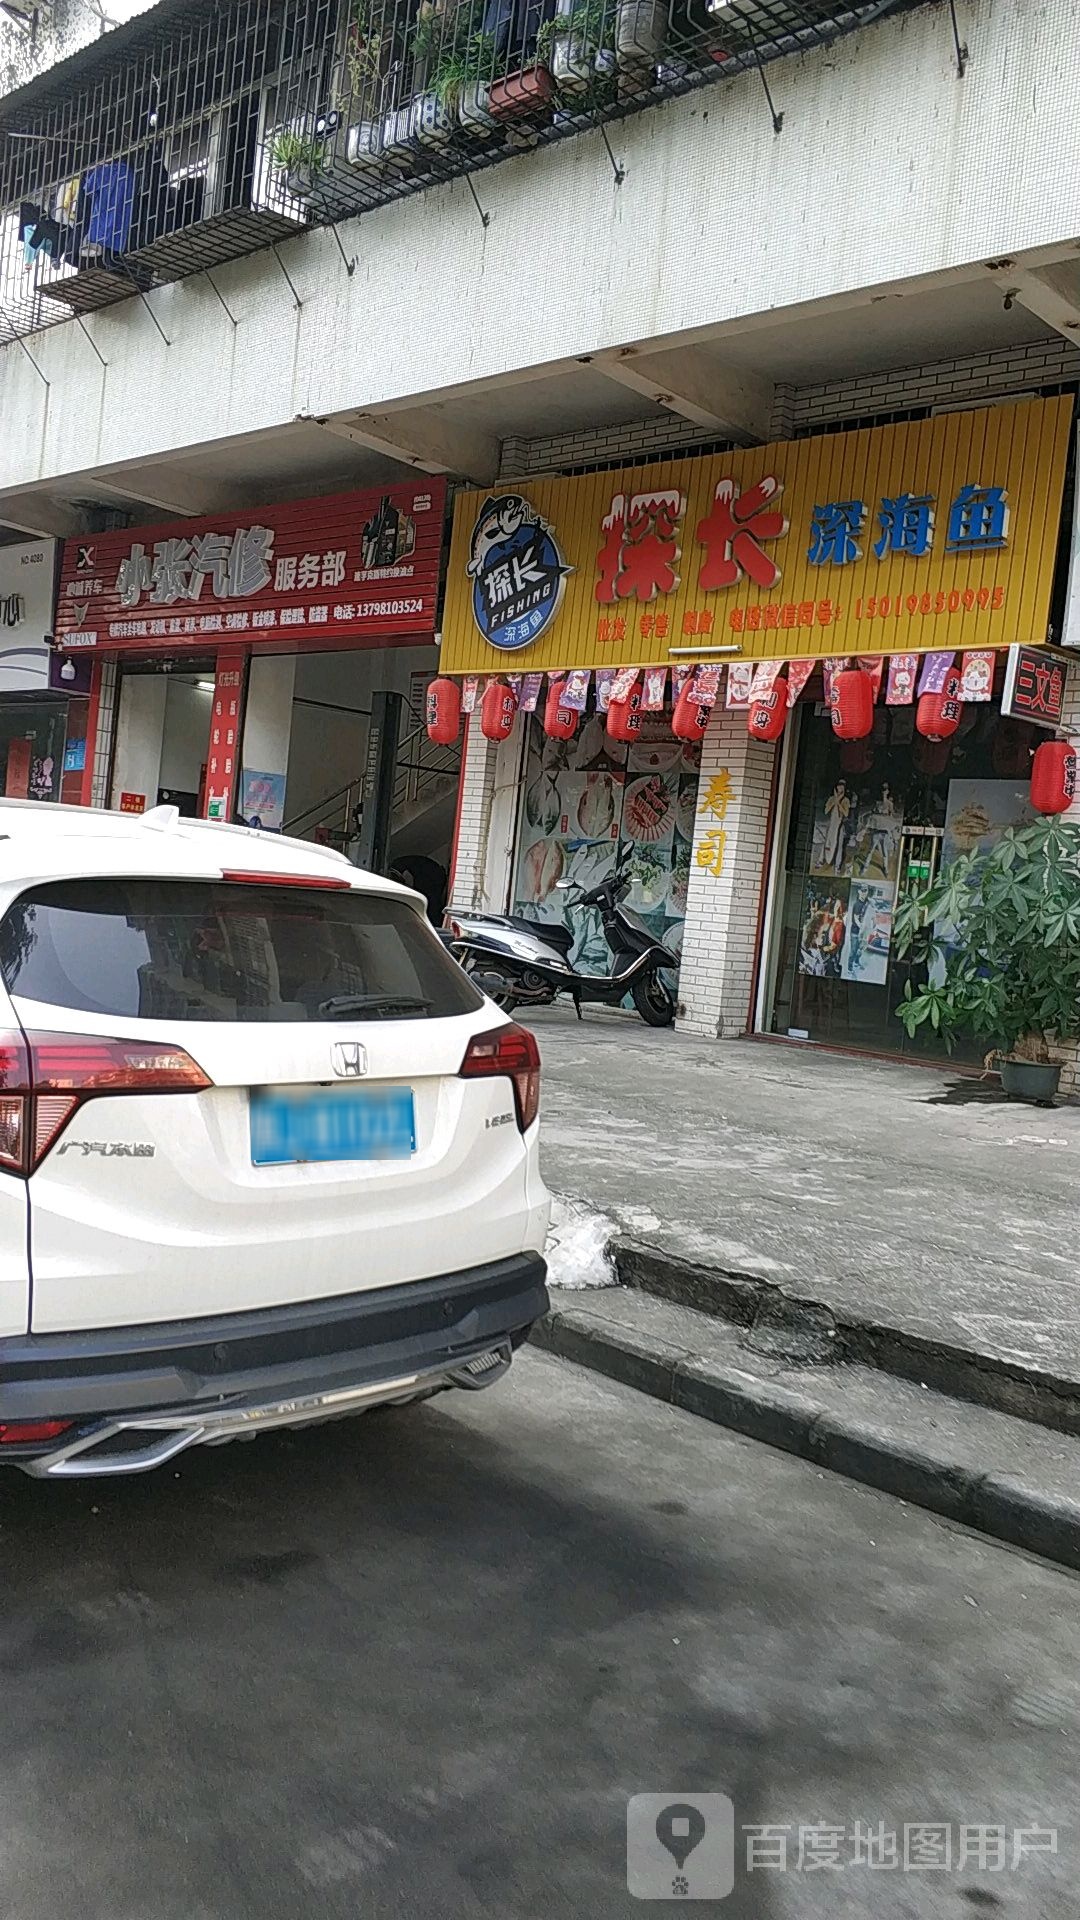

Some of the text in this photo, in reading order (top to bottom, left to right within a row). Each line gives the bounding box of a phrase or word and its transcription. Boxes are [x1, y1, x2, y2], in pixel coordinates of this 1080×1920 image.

[115, 525, 347, 608] 小张汽修 服务部
[595, 474, 1009, 604] 探长 深海鱼
[484, 546, 548, 608] 探长
[491, 583, 551, 628] FISHING
[504, 610, 544, 642] 深海鱼
[598, 616, 627, 642] 批发
[640, 613, 670, 639] 零售
[1016, 663, 1062, 715] 三文鱼
[697, 767, 737, 878] 寿司
